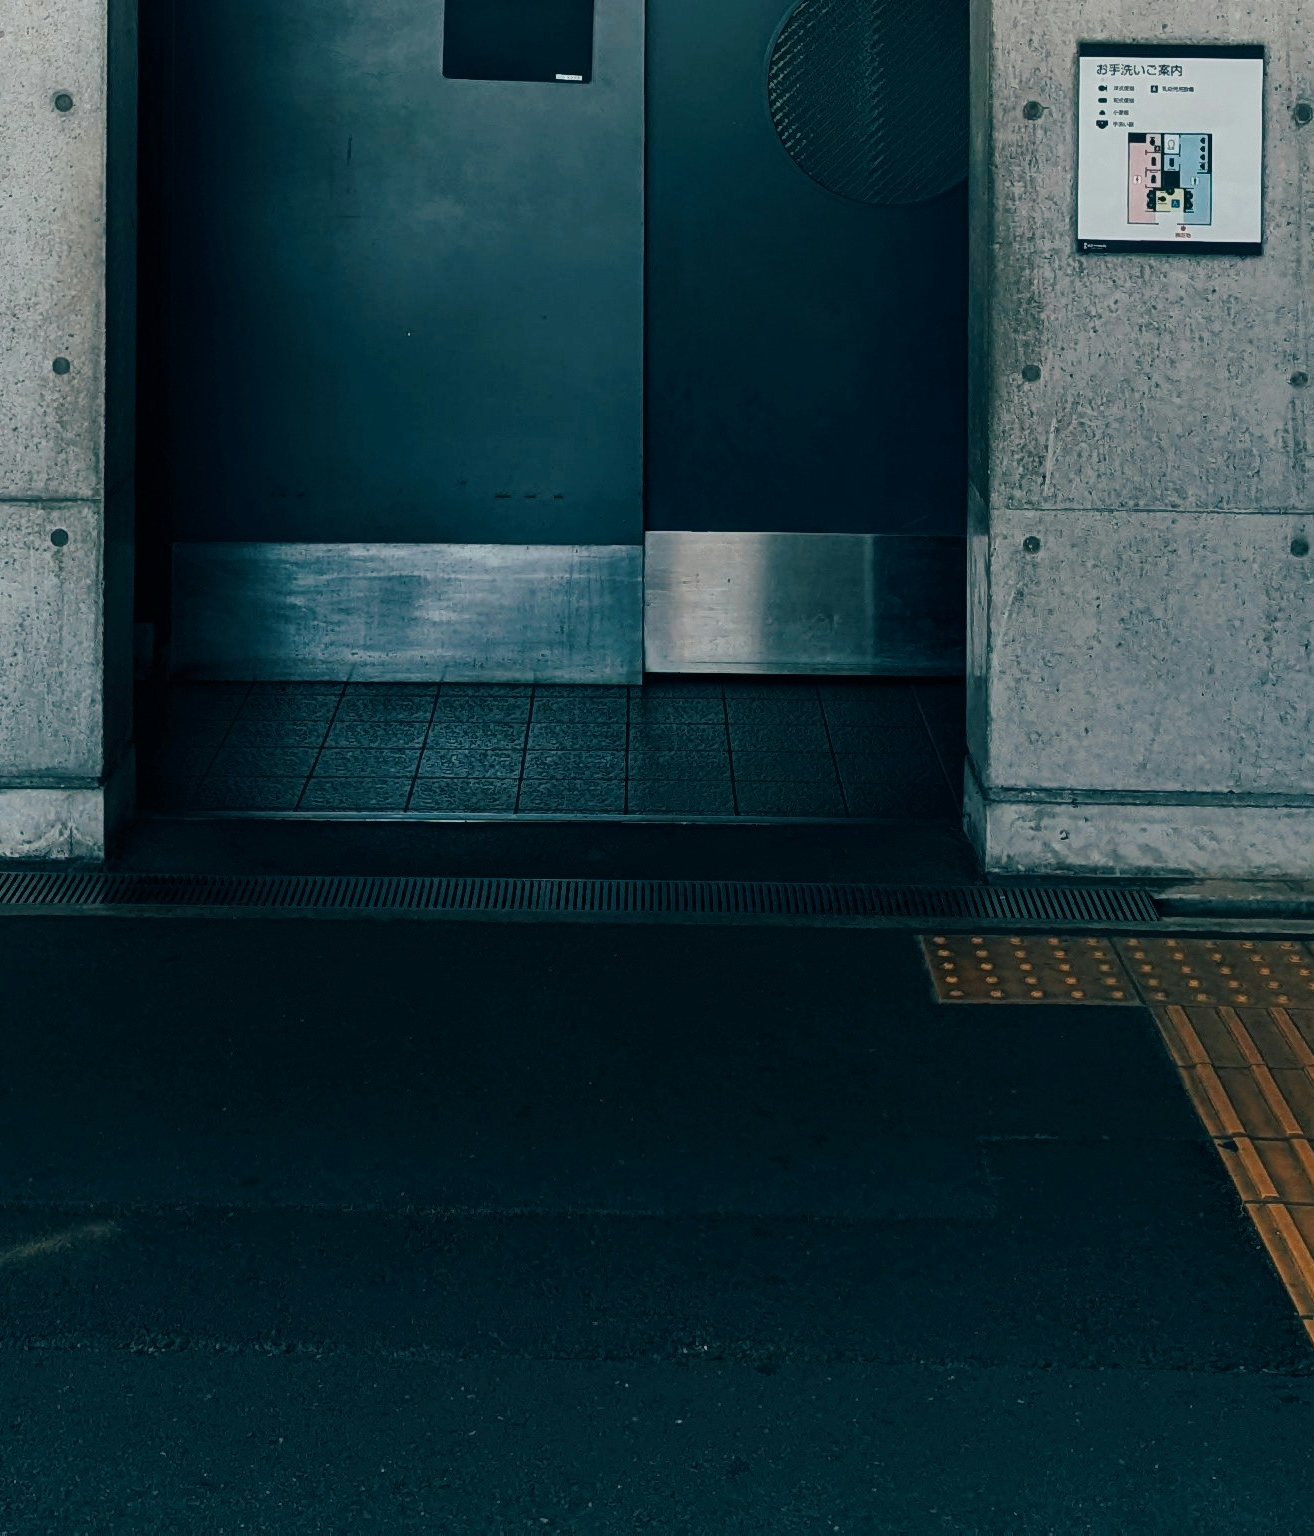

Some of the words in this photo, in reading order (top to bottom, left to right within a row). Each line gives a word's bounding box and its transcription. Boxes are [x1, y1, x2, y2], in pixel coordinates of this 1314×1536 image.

[1096, 63, 1183, 77] お手洗いご案内
